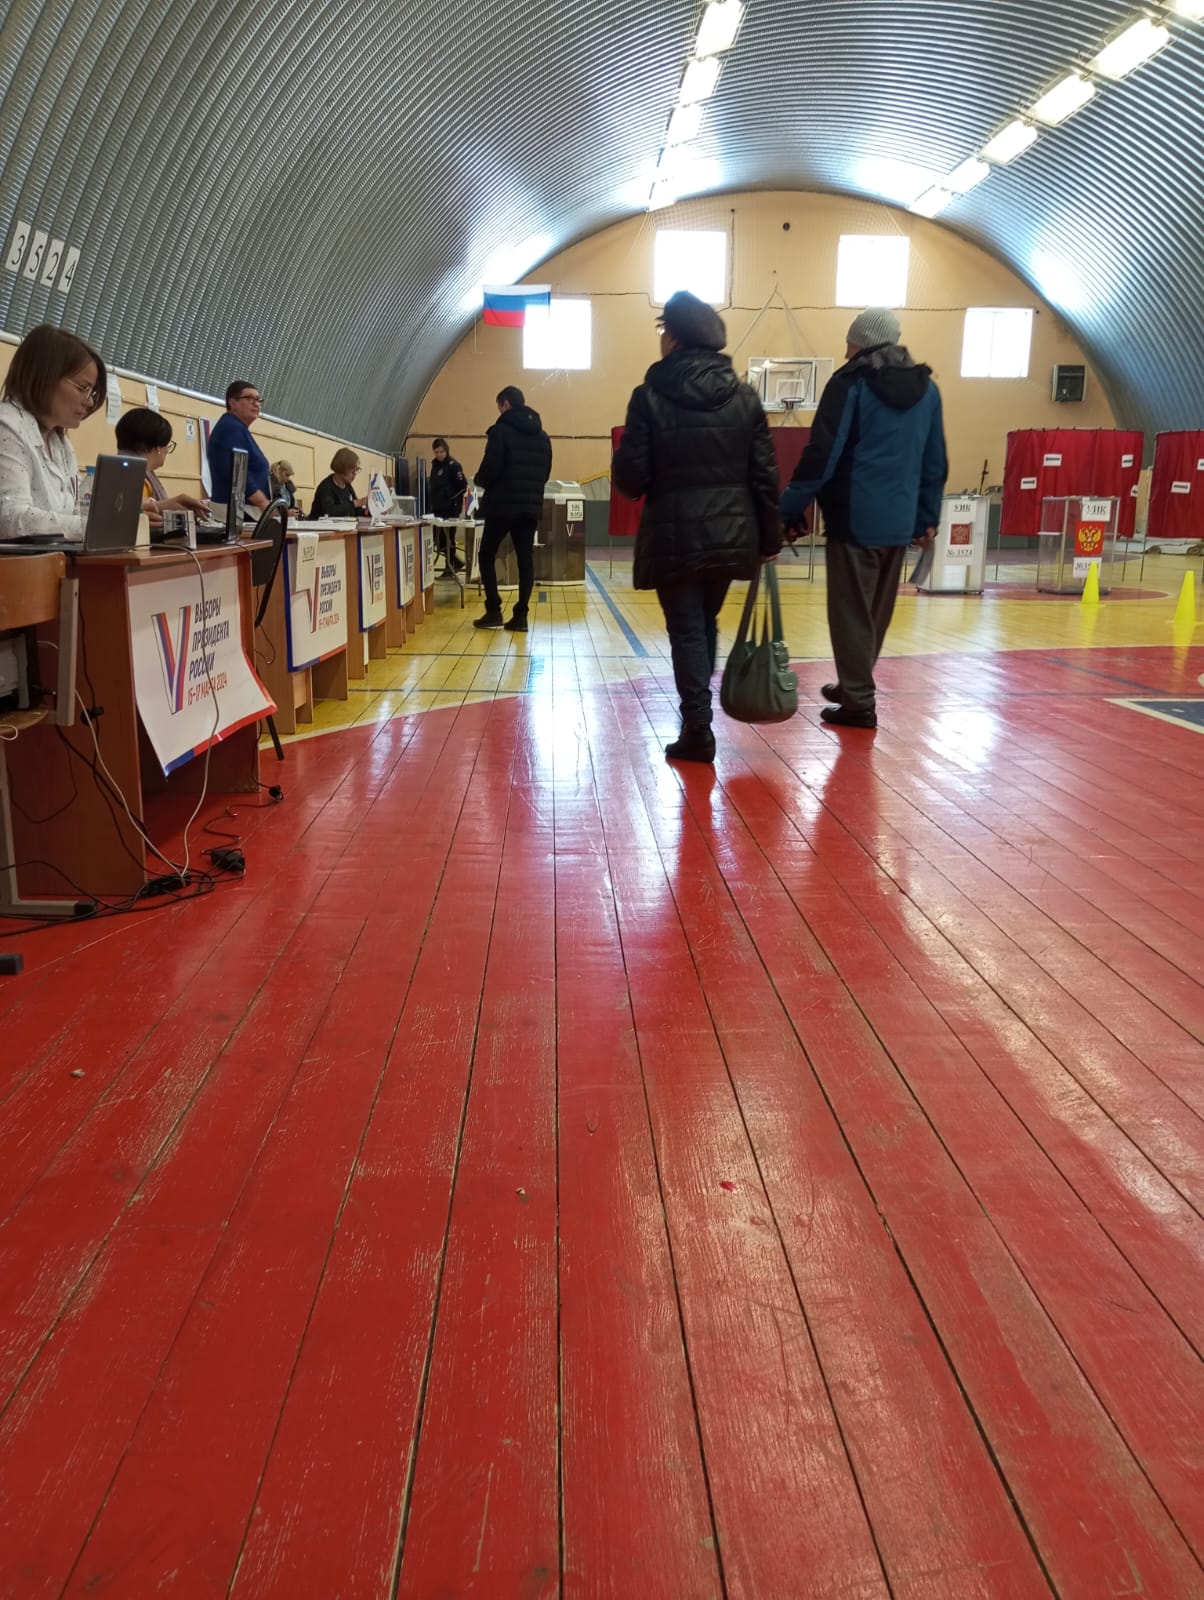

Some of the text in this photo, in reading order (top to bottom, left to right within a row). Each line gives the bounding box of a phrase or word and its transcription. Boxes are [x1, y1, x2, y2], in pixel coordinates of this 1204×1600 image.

[11, 234, 76, 288] 3524
[194, 596, 221, 624] ВЫБОРЫ
[191, 619, 229, 653] ПРЕЗИДЕНТА
[188, 651, 216, 680] РОССИИ
